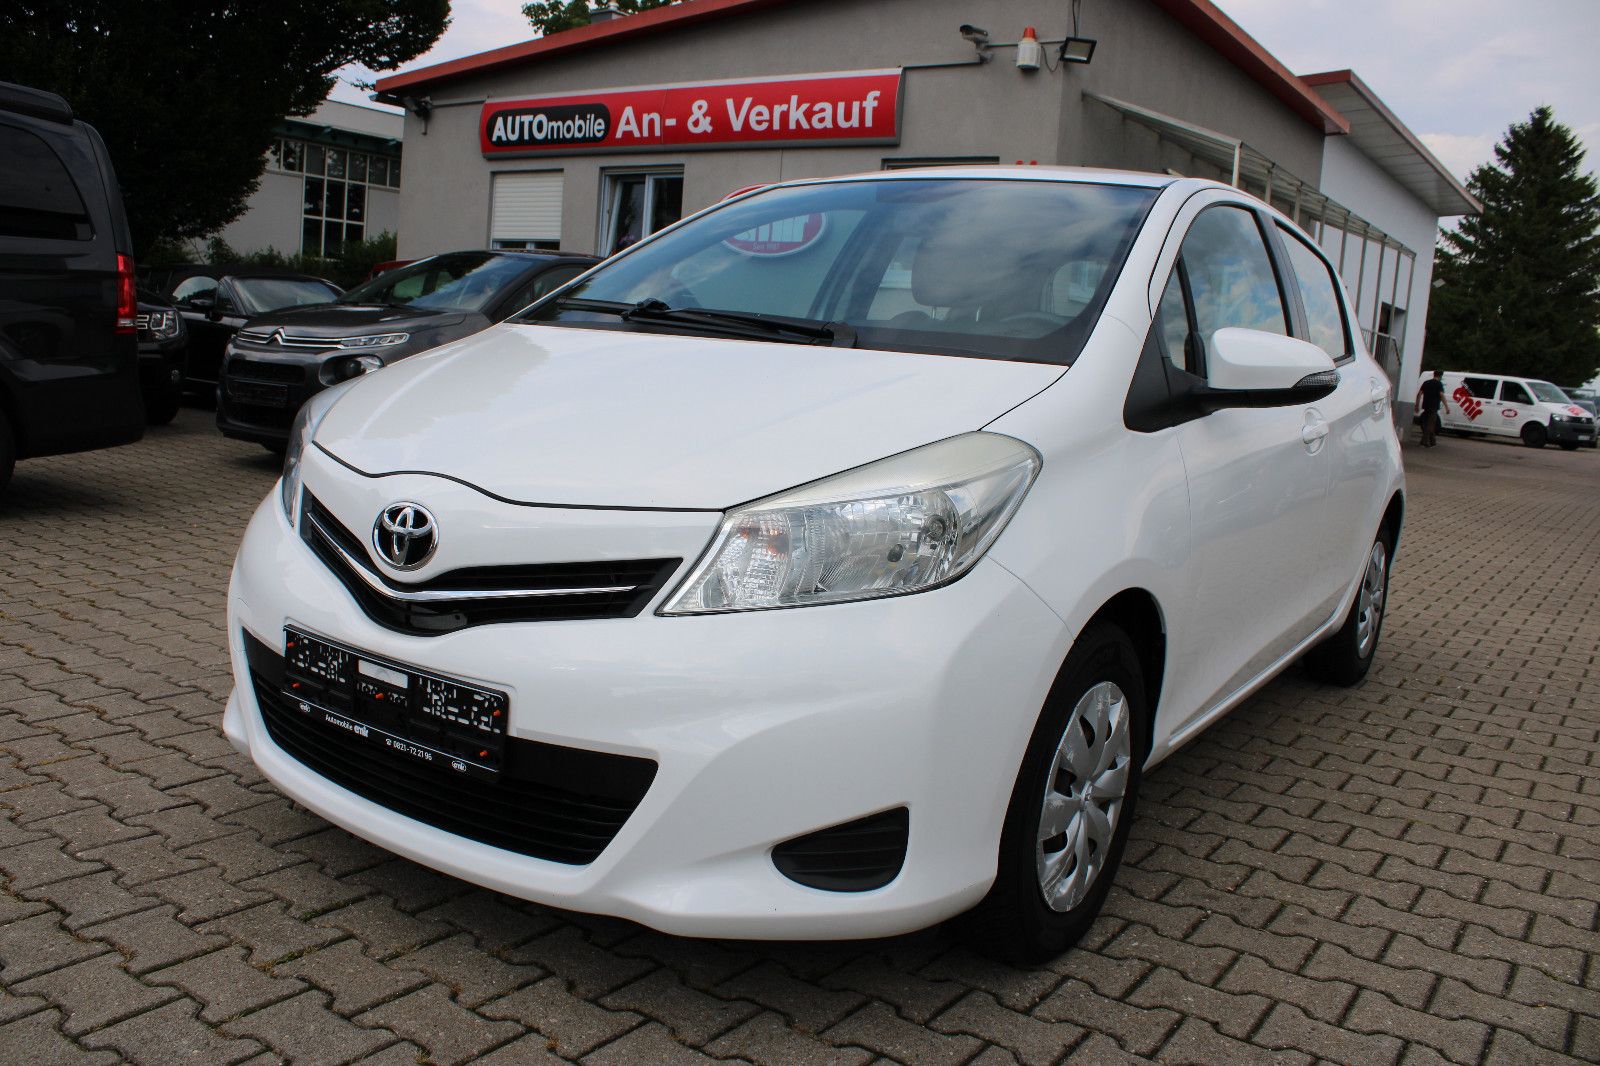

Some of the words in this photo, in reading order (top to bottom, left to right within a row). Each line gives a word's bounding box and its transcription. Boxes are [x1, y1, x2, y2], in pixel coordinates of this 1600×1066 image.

[492, 113, 605, 142] AUTOmobile
[615, 106, 676, 139] An-
[687, 99, 713, 134] &
[726, 90, 881, 132] Verkauf
[325, 713, 353, 731] Automobile
